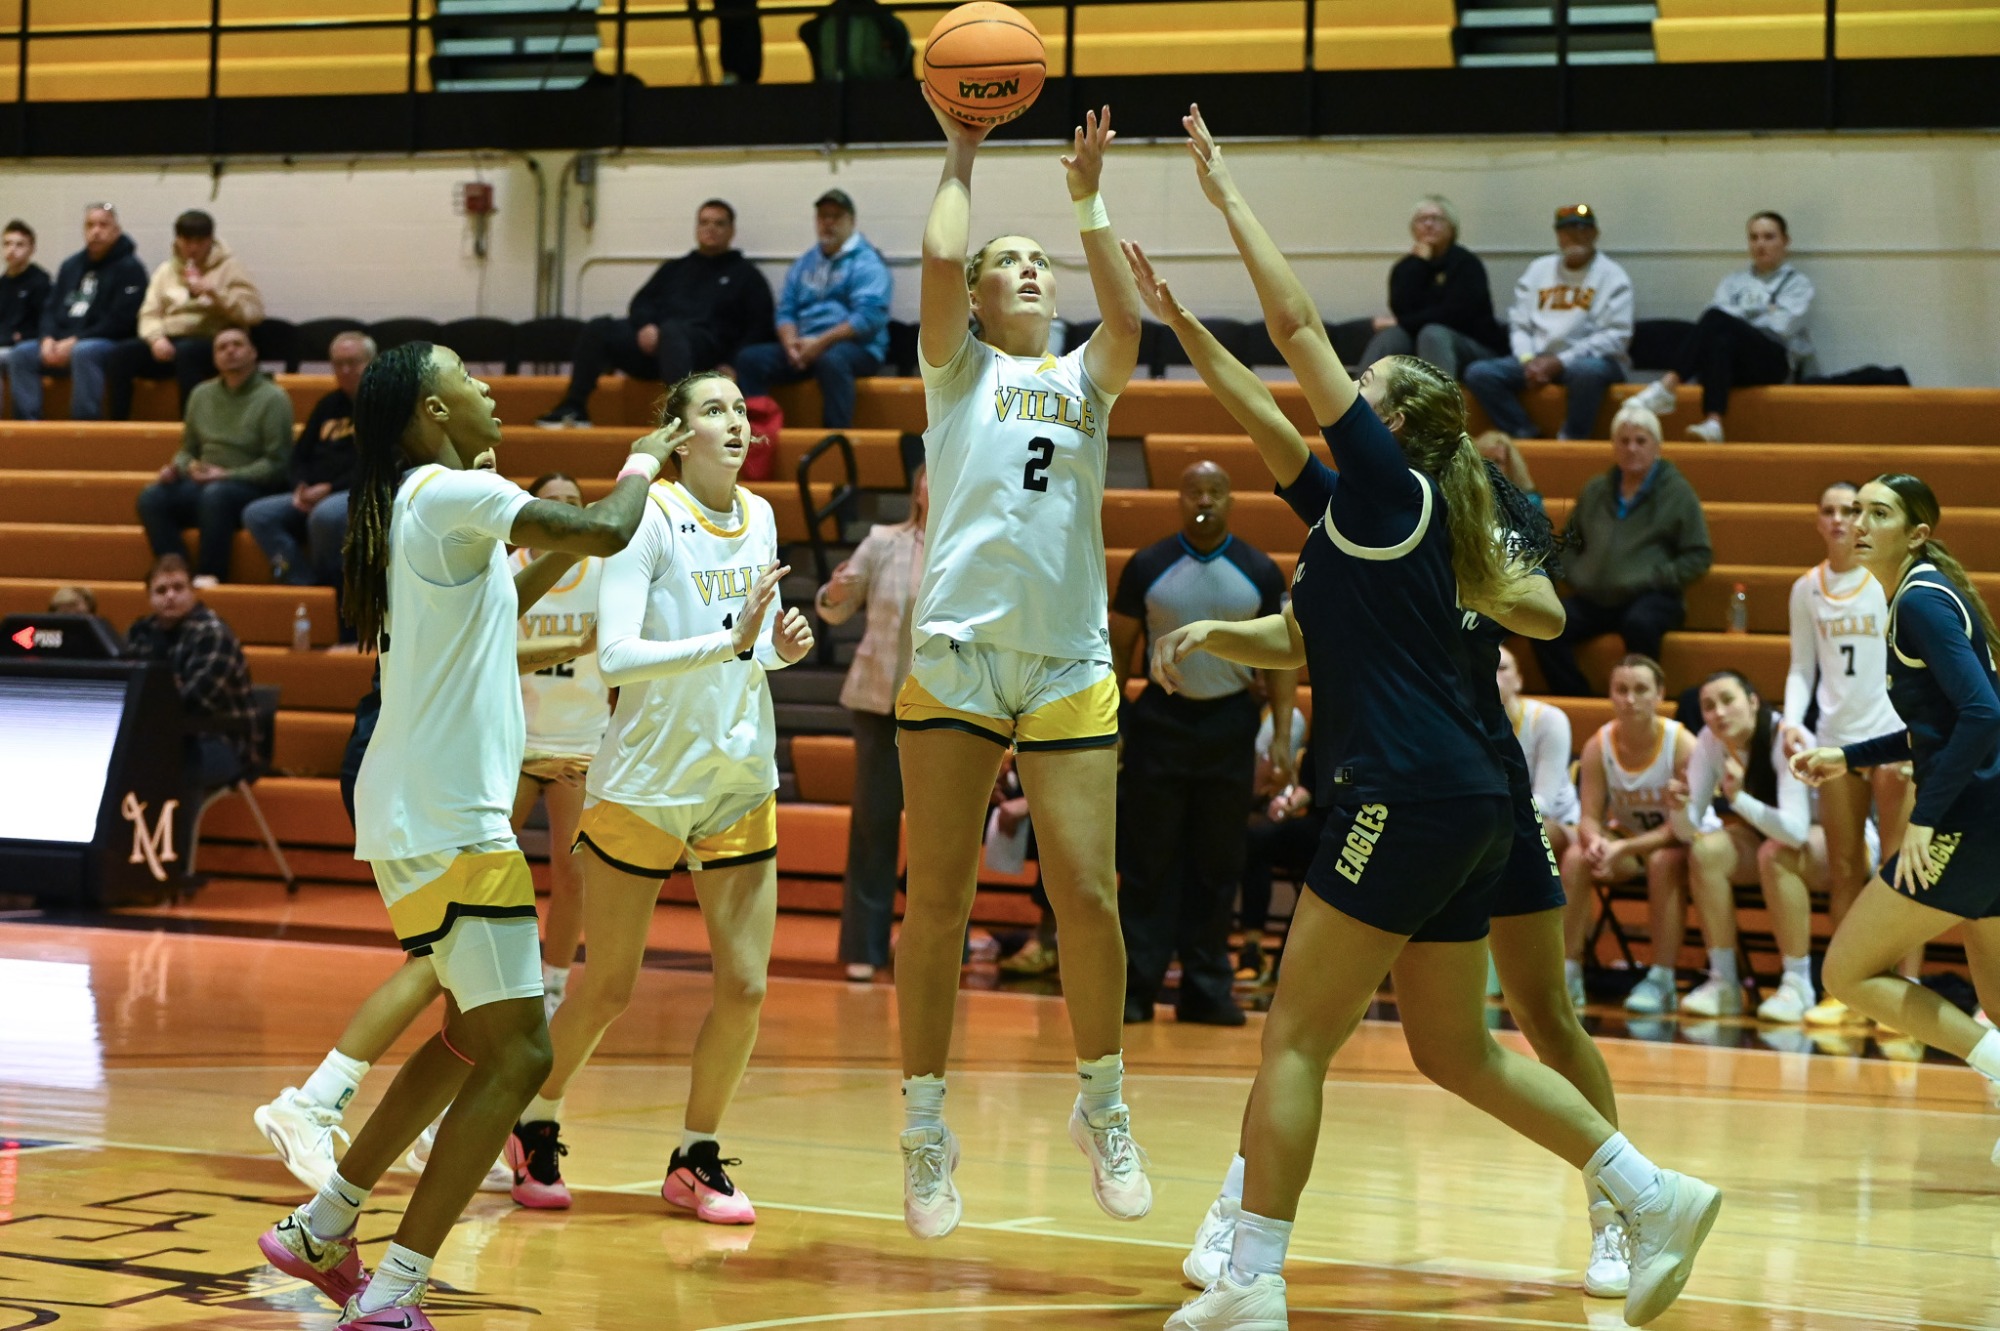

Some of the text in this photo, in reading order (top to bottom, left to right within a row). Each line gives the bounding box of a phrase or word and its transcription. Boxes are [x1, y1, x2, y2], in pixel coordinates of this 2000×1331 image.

[958, 78, 1020, 99] NCAA
[994, 385, 1096, 438] VILLE
[1022, 436, 1055, 492] 2
[691, 564, 770, 606] VILL
[1840, 645, 1856, 677] 7
[1334, 803, 1389, 885] EAGLES
